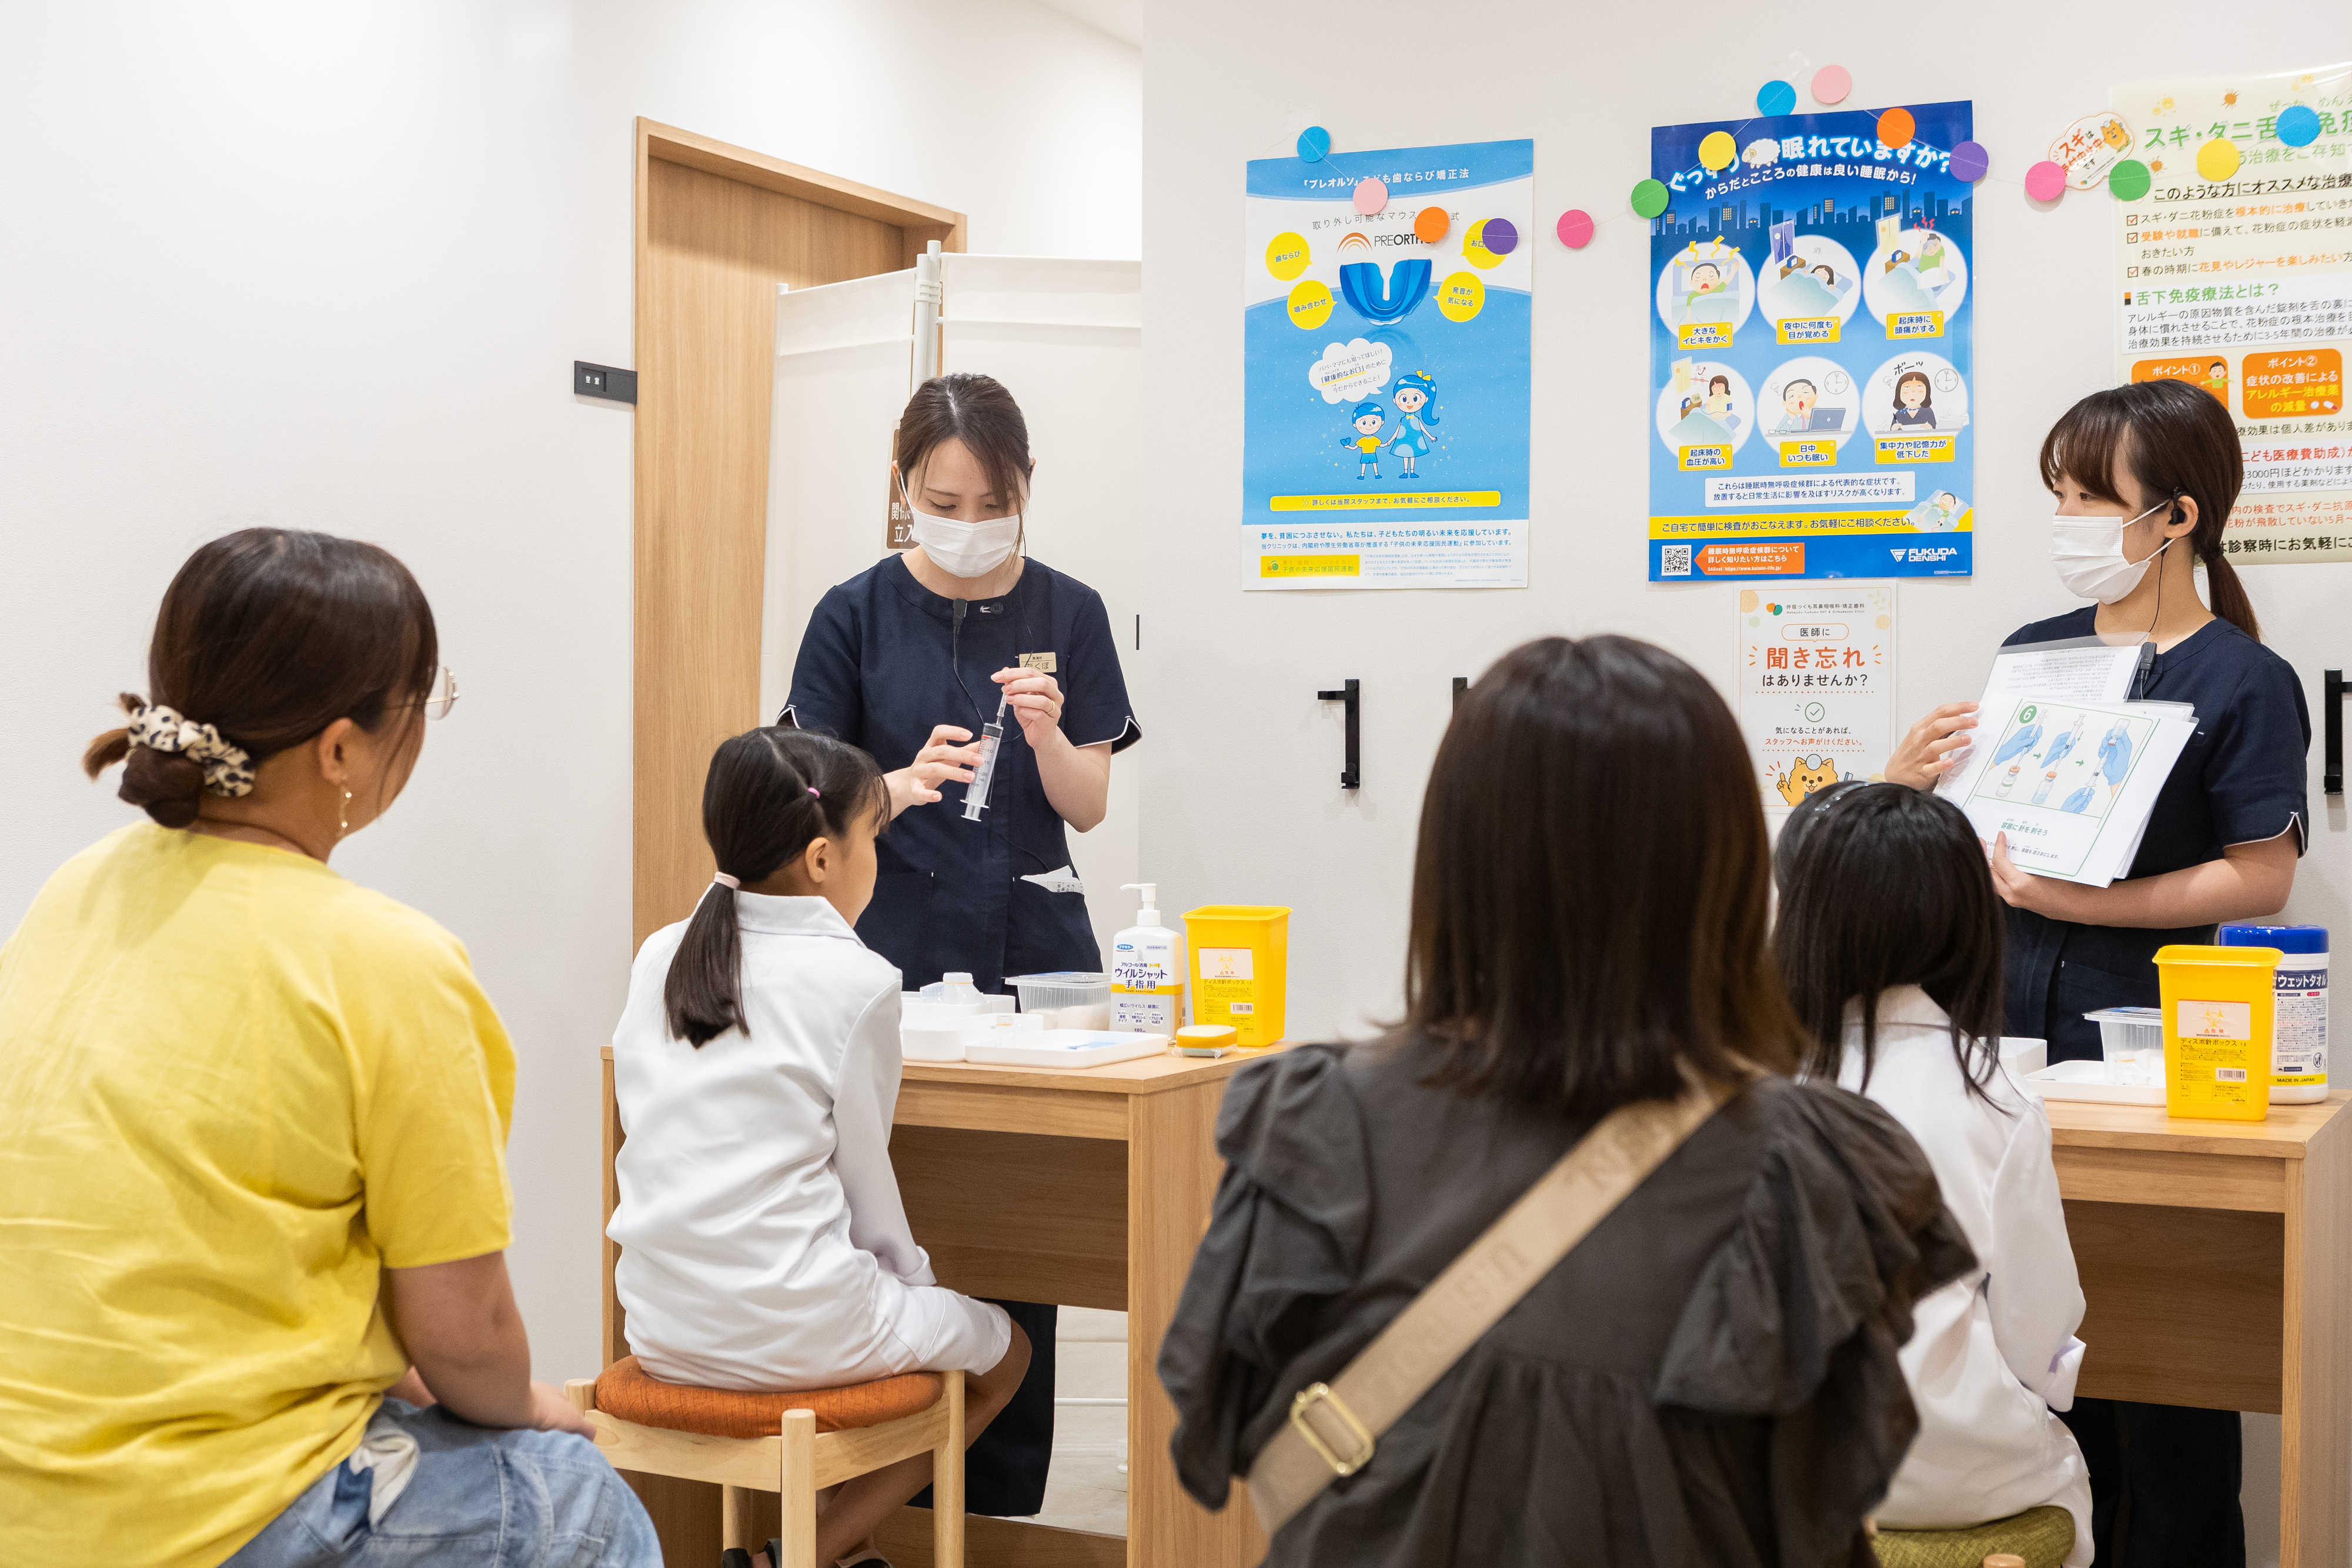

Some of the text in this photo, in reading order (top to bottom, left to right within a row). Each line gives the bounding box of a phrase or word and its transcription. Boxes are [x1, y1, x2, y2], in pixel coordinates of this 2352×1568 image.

[2145, 110, 2352, 148] スギ・ダニ舌免
[2083, 158, 2095, 169] です
[1705, 163, 1916, 200] からだとこころの健康は良い睡眠から!
[1312, 211, 1459, 230] 取り外し可能なマウス式
[1275, 250, 1301, 263] 歯ならび
[2141, 246, 2195, 260] おきたい方
[1452, 286, 1473, 296] 発音が
[2136, 283, 2279, 306] 舌下免疫療法とは?
[1447, 296, 1474, 307] 気になる
[1784, 320, 1833, 330] 夜中に何度も
[1898, 315, 1931, 325] 起床時に
[1693, 327, 1716, 336] 大きな
[1788, 329, 1829, 339] 目が覚める
[1895, 324, 1935, 335] 頭痛がする
[1683, 335, 1728, 346] イビキをかく
[2246, 370, 2339, 387] 症状の改善による
[2246, 384, 2340, 401] アレルギー治療薬
[1800, 444, 1815, 453] 日中
[1880, 440, 1946, 451] 集中力や記憶力が
[1690, 448, 1720, 457] 起床時の
[1788, 452, 1828, 462] いつも眠い
[1896, 449, 1929, 459] 低下した
[1686, 456, 1725, 467] 血圧が高い
[2242, 464, 2352, 480] 3000円ほどかかります
[1718, 477, 1900, 490] これらは睡眠時無呼吸症候群による代表的な症状です。
[1713, 488, 1906, 501] 放置すると日常生活に影響を及ぼすリスクが高くなります。
[1312, 496, 1471, 507] 詳しくは当院スタッフまで、お気軽にご相談ください。
[1662, 517, 1916, 533] ご自宅で簡単に検査がおこなえます。お気軽にご相談ください。
[1708, 546, 1799, 554] 睡眠時無呼吸症候群について
[1708, 555, 1787, 563] 詳しく知りたい方はこちら
[1800, 627, 1830, 637] 医師に
[1767, 646, 1865, 670] 聞き忘れ
[1762, 674, 1867, 687] はありませんか?
[2023, 708, 2033, 721] 6
[1775, 726, 1852, 735] 気になることがあれば、
[1765, 738, 1863, 747] スタッフへお声がけください。
[1115, 968, 1168, 979] ウイルシャット
[1125, 979, 1155, 989] 手指用
[2278, 974, 2326, 988] ウェットタオル
